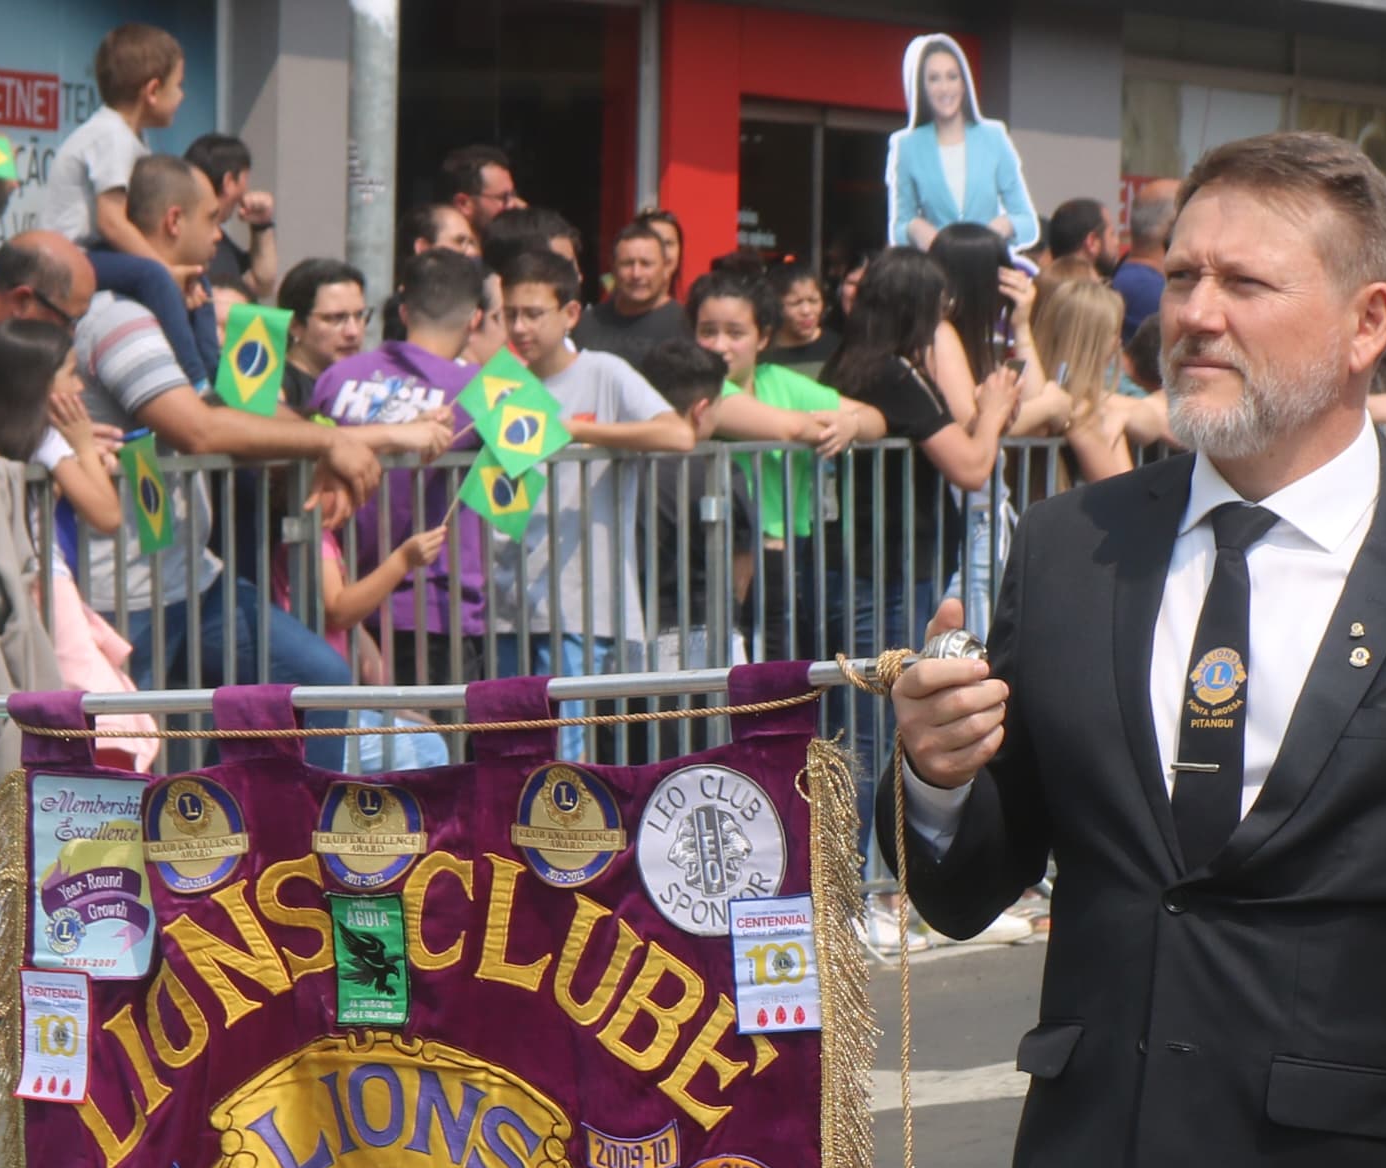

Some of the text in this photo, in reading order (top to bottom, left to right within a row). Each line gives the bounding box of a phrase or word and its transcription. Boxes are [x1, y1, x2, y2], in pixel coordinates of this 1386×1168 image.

[1211, 665, 1226, 685] L
[1211, 699, 1244, 717] GROSSA
[1190, 718, 1234, 729] PITANGUI
[362, 790, 379, 811] L
[558, 784, 574, 807] L
[647, 774, 763, 834] LEO CLUB
[181, 796, 200, 817] L
[54, 817, 140, 842] Excellence
[518, 829, 619, 842] CLUB EXCELLENCE
[319, 834, 419, 846] CLUB EXCELLENCE
[350, 844, 385, 853] AWARD
[549, 840, 585, 849] AWARD
[693, 809, 723, 885] LEO
[659, 871, 773, 927] SPONOR
[87, 900, 128, 920] Growth
[736, 914, 810, 929] CENTENNIAL
[744, 941, 808, 986] 100
[26, 984, 86, 1001] CENTENNIAL
[401, 851, 779, 1132] CLUBE
[33, 1014, 79, 1058] 100
